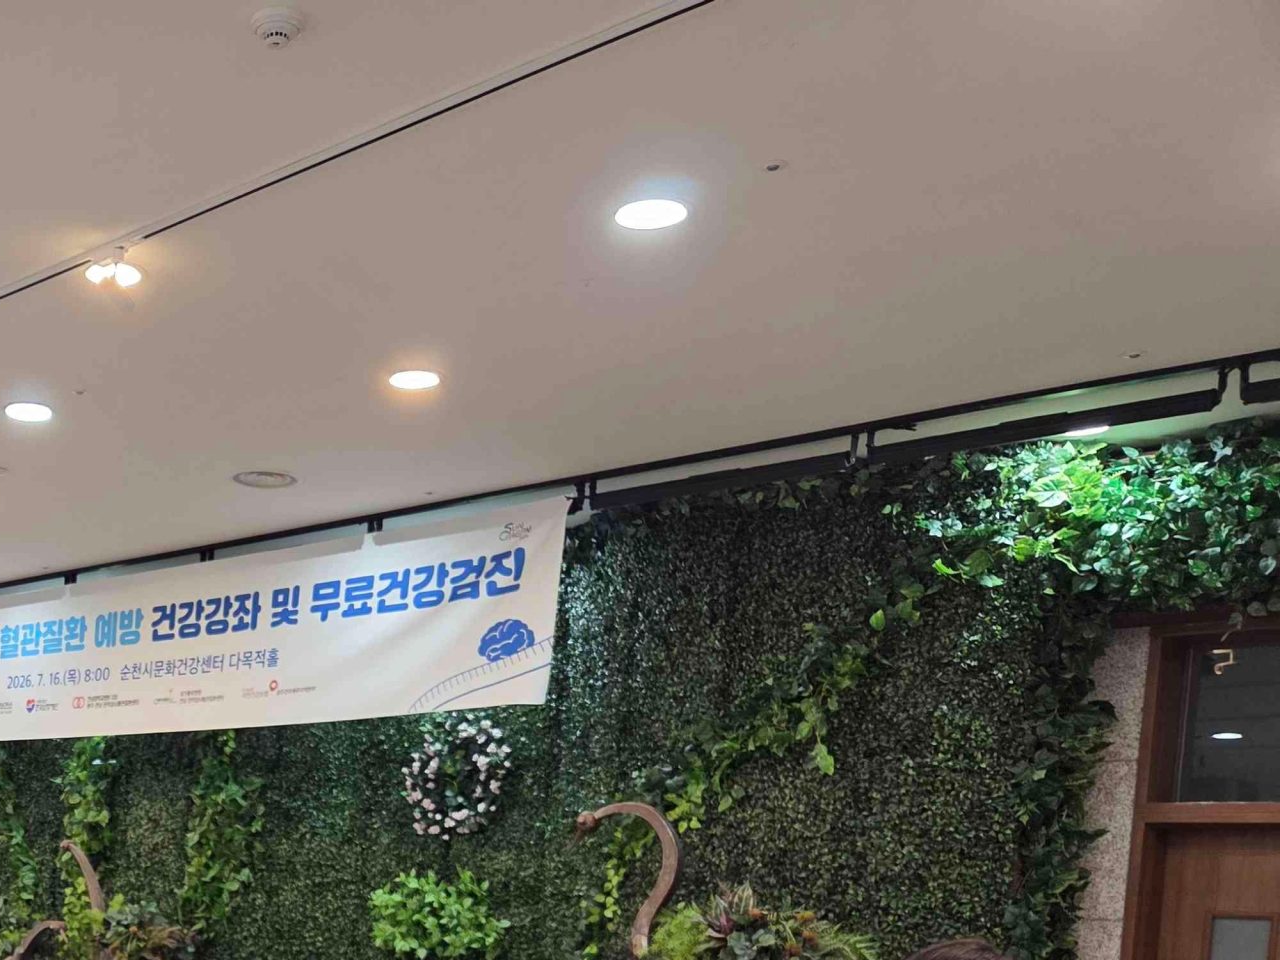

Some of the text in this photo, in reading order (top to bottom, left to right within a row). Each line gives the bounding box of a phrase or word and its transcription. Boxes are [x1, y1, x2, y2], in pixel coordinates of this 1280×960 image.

[94, 607, 145, 648] 예방
[151, 591, 261, 642] 건강강좌
[270, 585, 300, 628] 및
[310, 547, 527, 622] 무료건강검진
[7, 674, 34, 689] 2026.
[84, 667, 111, 683] 8:00
[120, 654, 224, 681] 순천시문화건강센터
[229, 648, 279, 670] 다목적홀
